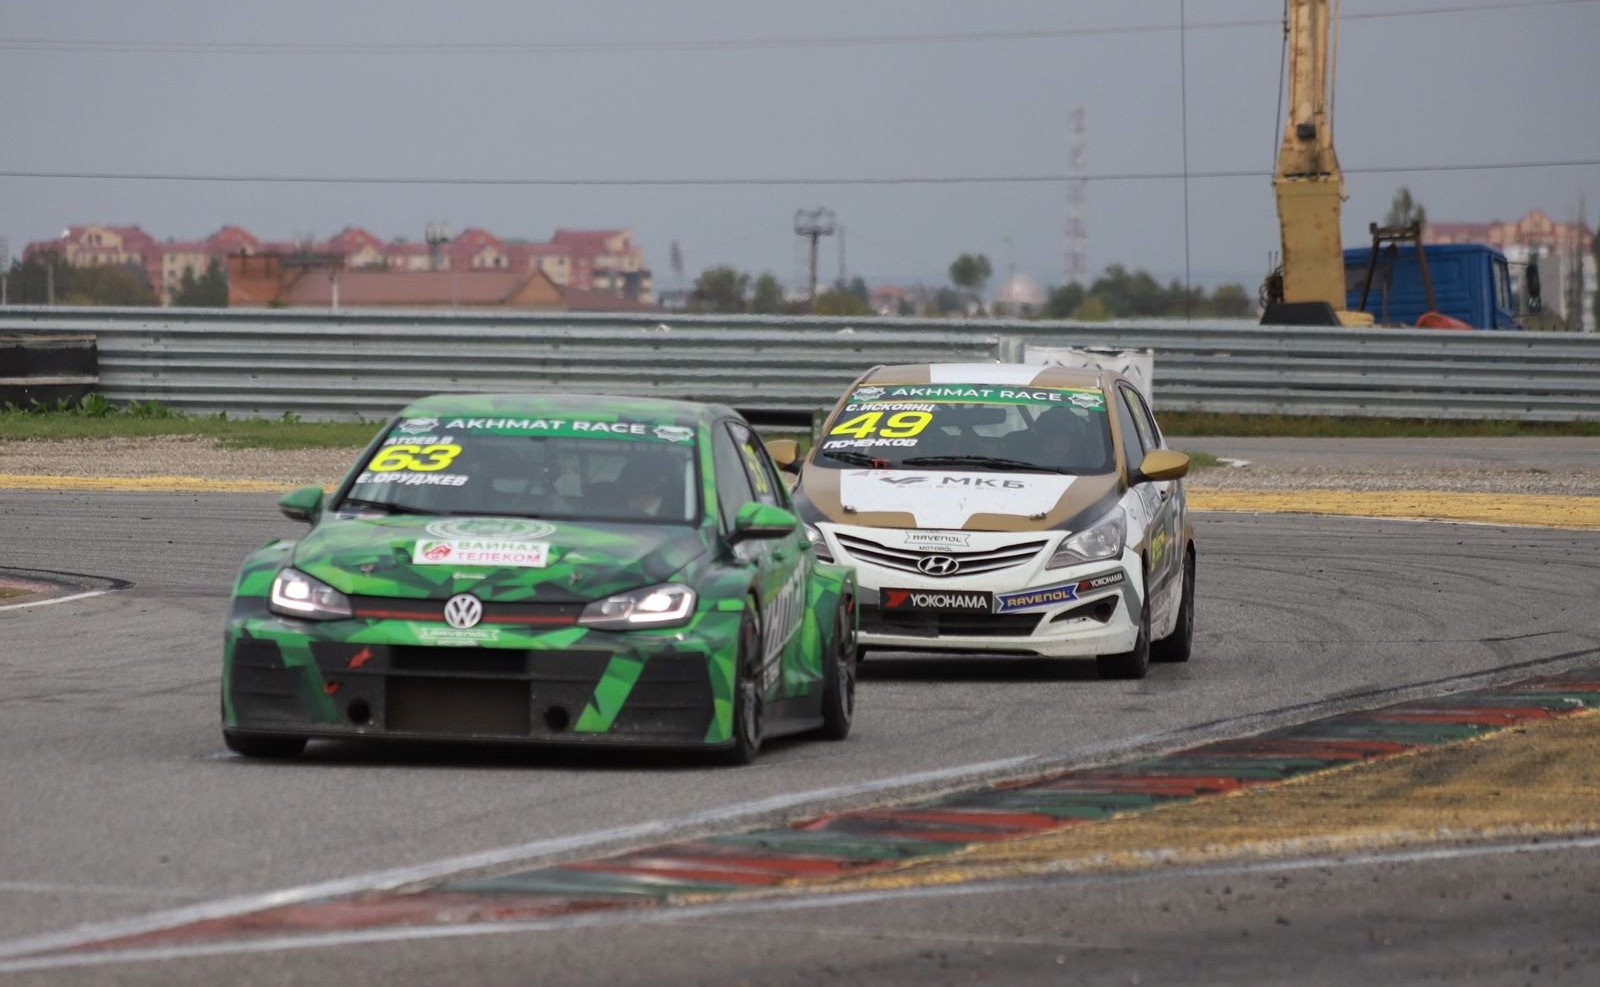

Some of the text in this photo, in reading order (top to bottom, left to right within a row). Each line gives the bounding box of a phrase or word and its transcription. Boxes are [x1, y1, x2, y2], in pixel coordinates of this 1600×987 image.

[891, 388, 993, 398] AKHMAT
[1000, 390, 1062, 401] RACE
[446, 418, 646, 434] AKHMAT RACE
[829, 411, 933, 438] 49
[823, 438, 918, 449] ПОЧЕНКОВ
[368, 444, 462, 472] 63
[355, 471, 469, 486] Е.ОРУДЖЕВ
[942, 476, 1025, 489] МКБ
[912, 534, 963, 543] RAVENOL
[1090, 573, 1124, 588] YOKOHAMA
[910, 594, 989, 609] YOKOHAMA
[1007, 590, 1070, 607] RAVENOL
